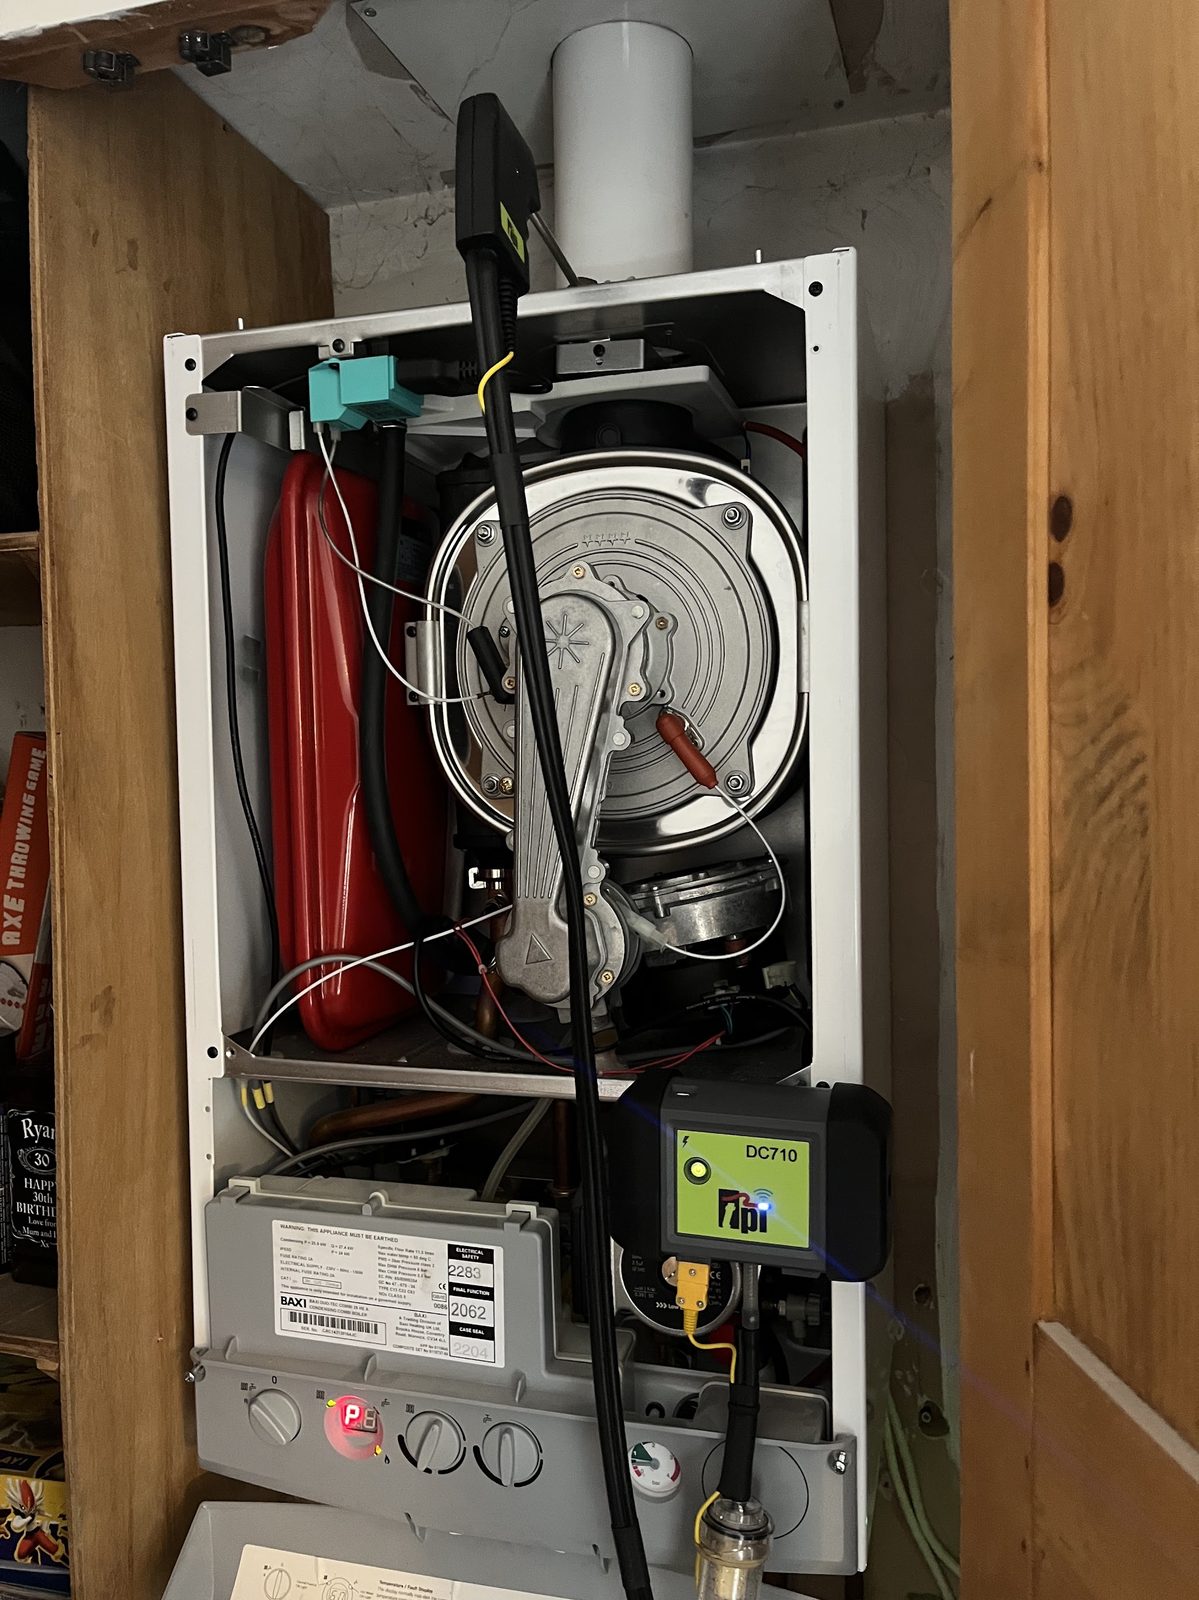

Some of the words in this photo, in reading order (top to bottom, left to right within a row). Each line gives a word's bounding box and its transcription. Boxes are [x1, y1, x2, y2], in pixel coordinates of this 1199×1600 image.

[26, 747, 47, 791] GAME
[7, 793, 36, 890] THROWING
[2, 894, 25, 946] AXE
[34, 1152, 50, 1167] 30
[746, 1145, 798, 1162] DC710
[32, 1192, 53, 1204] 30th
[28, 1216, 43, 1226] Love
[22, 1226, 39, 1236] Mum
[40, 1228, 52, 1238] and
[456, 1247, 483, 1255] ELECTRICAL
[448, 1264, 481, 1280] 2283
[281, 1296, 307, 1308] BAXI
[451, 1302, 486, 1320] 2062
[454, 1342, 488, 1360] 2204
